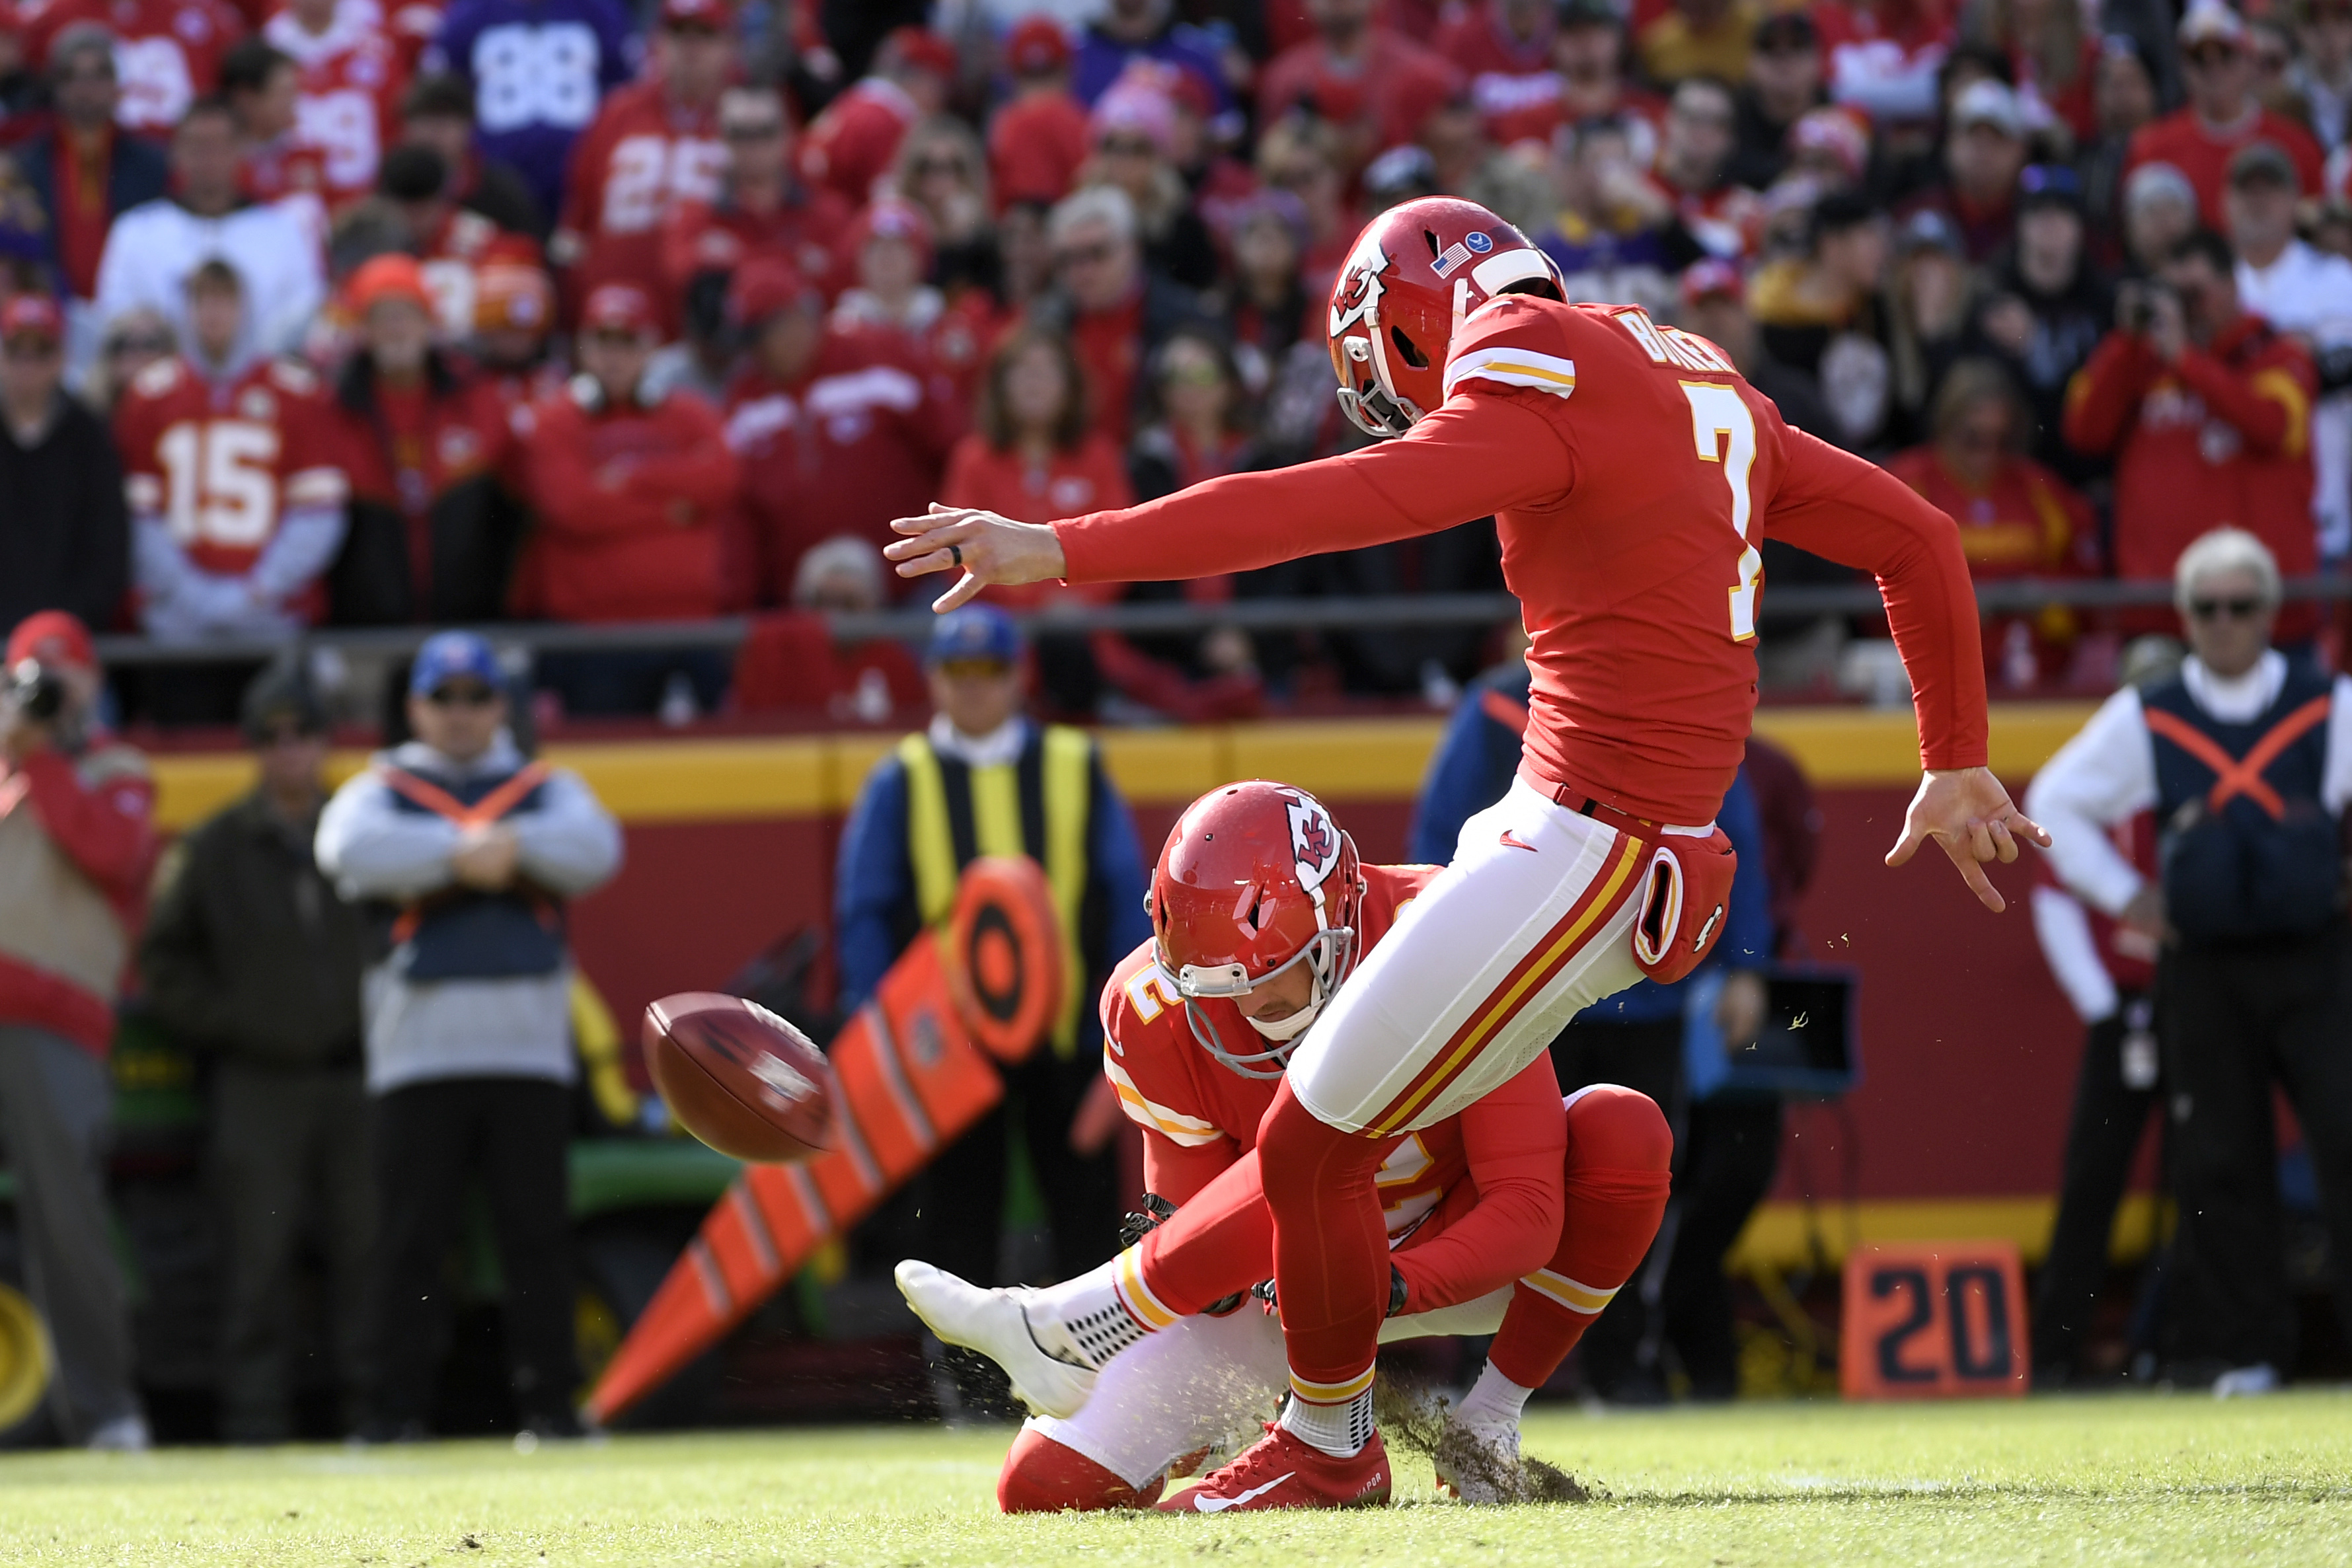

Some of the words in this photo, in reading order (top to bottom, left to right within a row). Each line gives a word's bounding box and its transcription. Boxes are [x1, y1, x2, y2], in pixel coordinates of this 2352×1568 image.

[471, 22, 600, 132] 88
[156, 420, 282, 546] 15
[1678, 380, 1762, 642] 7
[1870, 1269, 2010, 1382] 20
[1356, 1472, 1381, 1498] VAPOR
